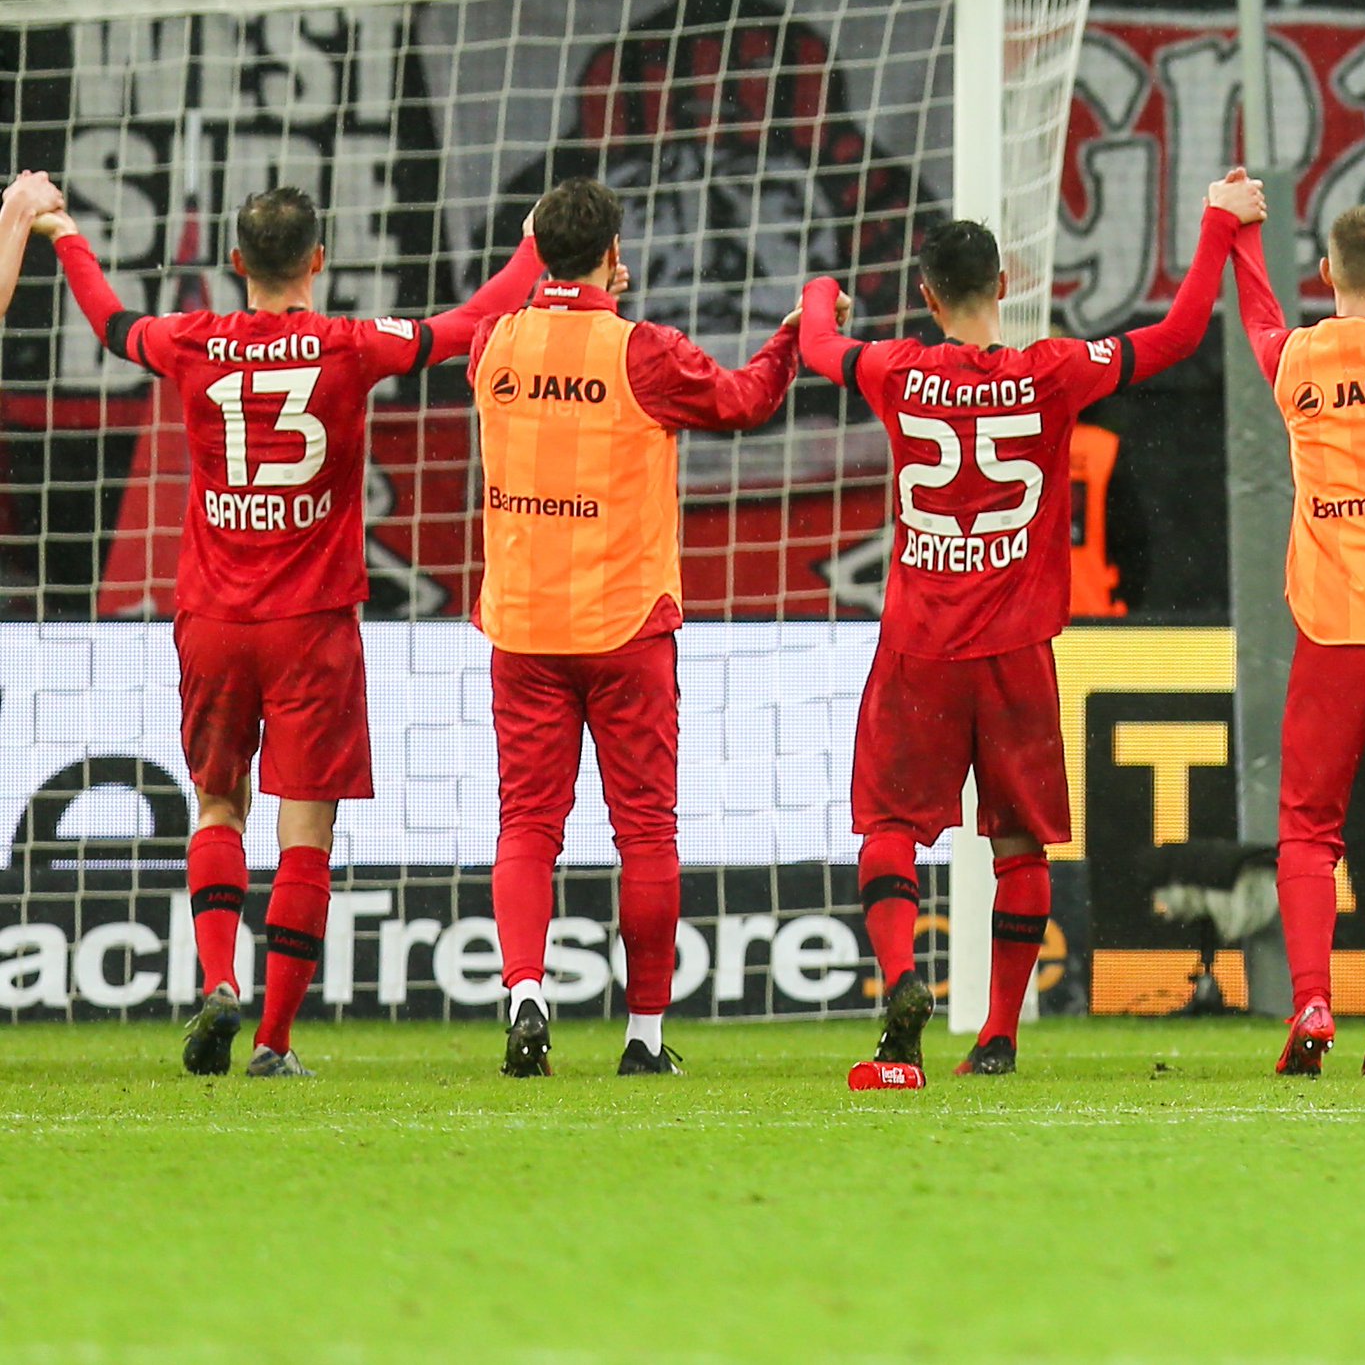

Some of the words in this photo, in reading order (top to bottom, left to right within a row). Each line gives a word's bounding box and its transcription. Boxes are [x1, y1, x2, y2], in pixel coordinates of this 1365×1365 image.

[206, 333, 321, 363] ALARIO
[527, 375, 607, 404] JAKO
[903, 368, 1037, 407] PALACIOS
[205, 366, 328, 487] 13
[897, 411, 1044, 537] 25
[204, 488, 286, 531] BAYER
[293, 488, 333, 529] 04
[488, 485, 600, 519] Barmenia
[900, 527, 985, 573] BAYER
[988, 527, 1029, 570] 04
